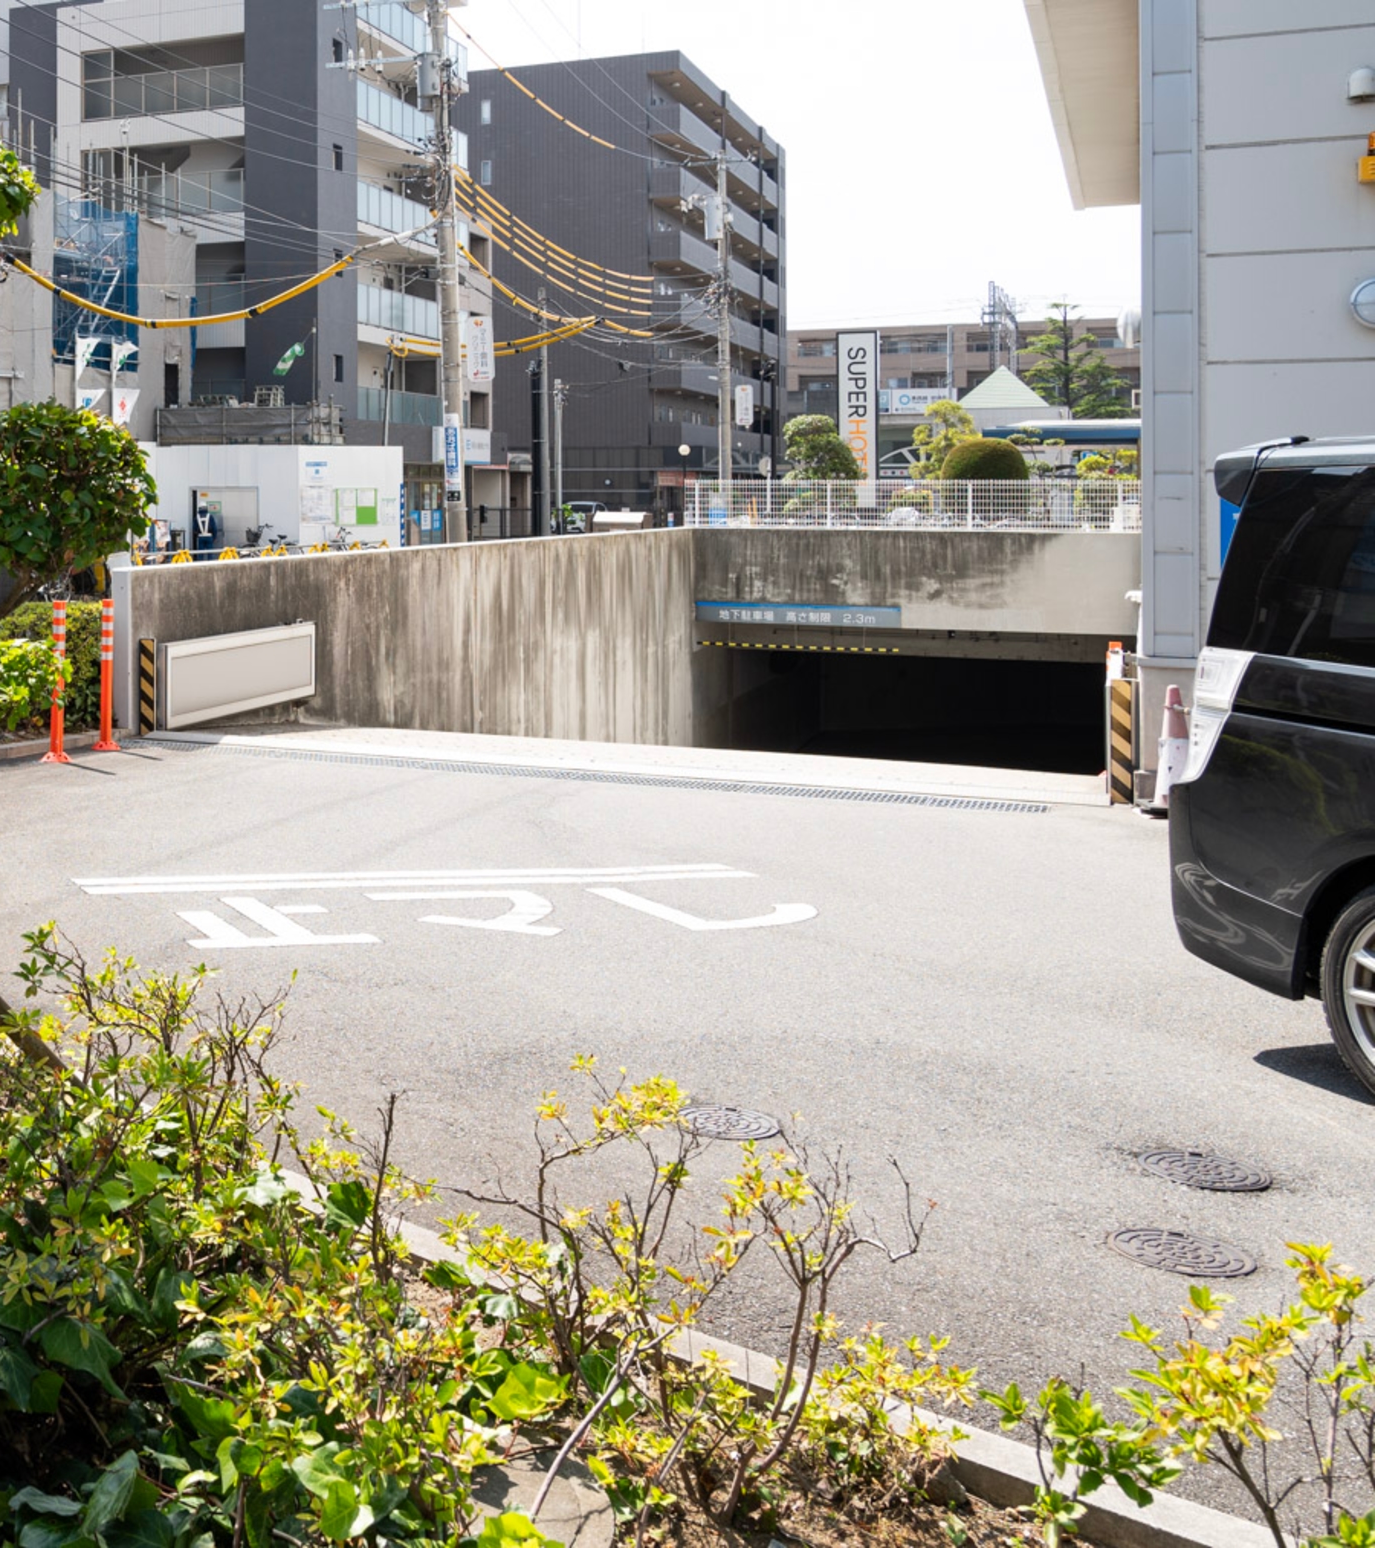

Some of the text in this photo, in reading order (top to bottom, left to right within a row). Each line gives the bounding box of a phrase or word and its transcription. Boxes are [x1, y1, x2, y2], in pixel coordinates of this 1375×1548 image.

[718, 609, 876, 625] 地下駐車場 高さ制限 2.3m
